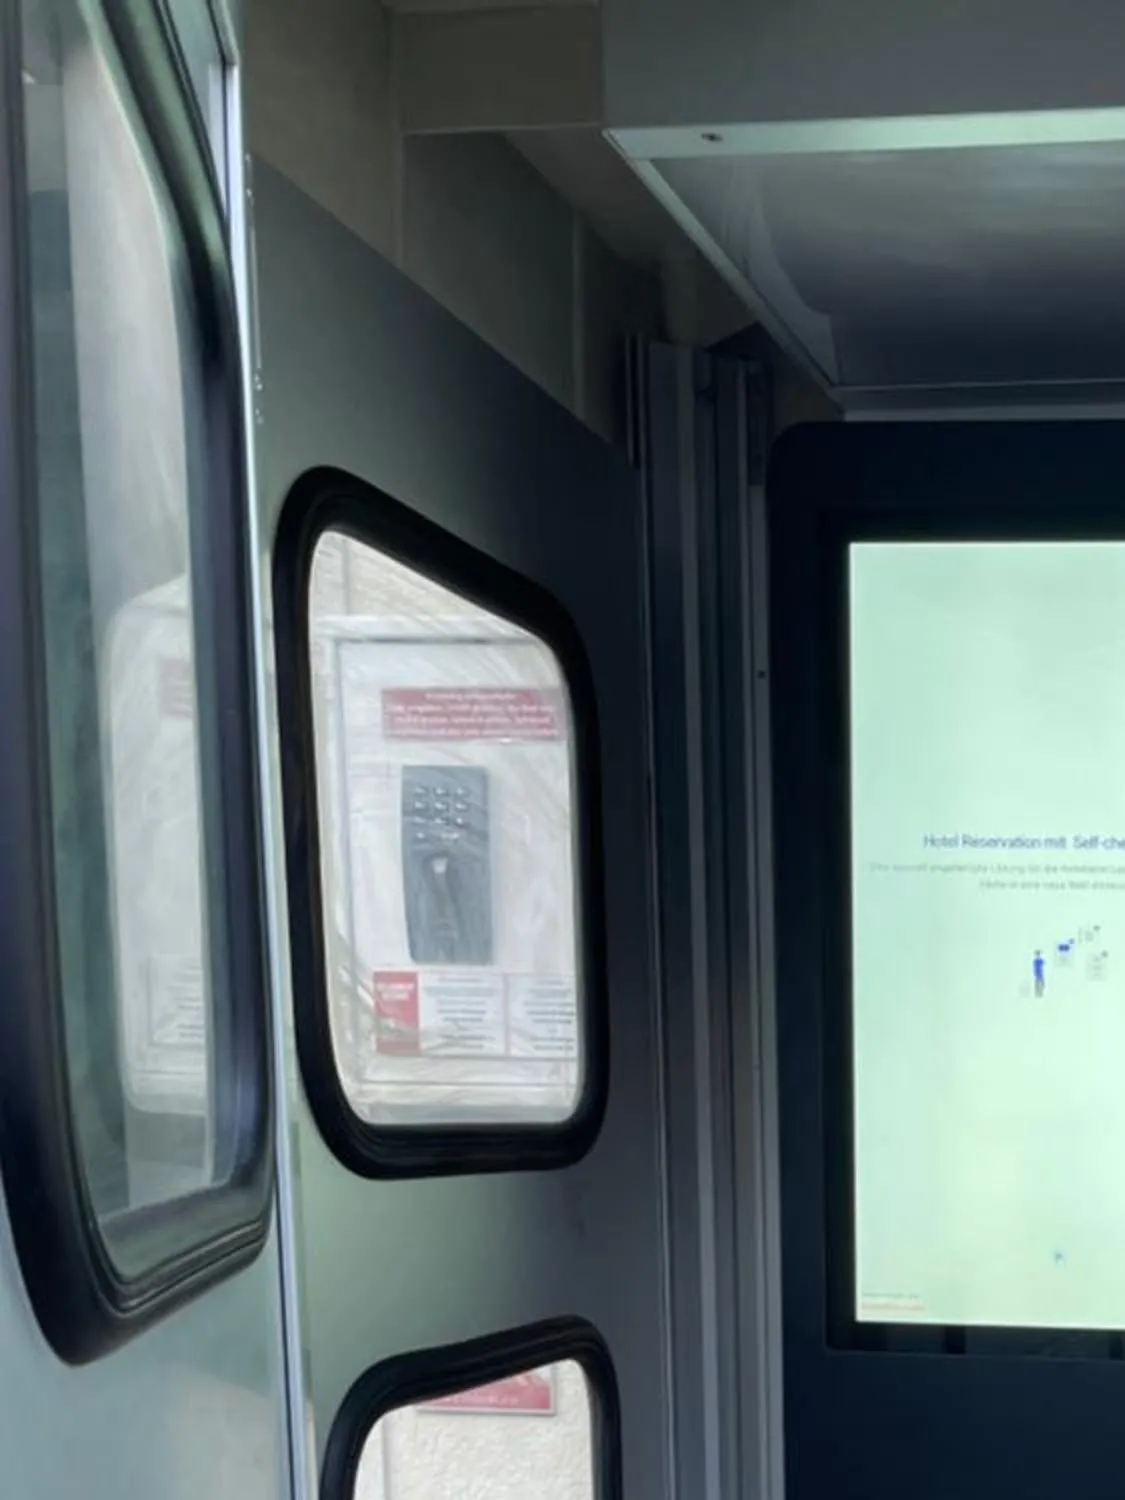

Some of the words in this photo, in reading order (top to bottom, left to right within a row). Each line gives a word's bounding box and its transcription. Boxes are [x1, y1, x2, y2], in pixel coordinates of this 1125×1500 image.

[923, 833, 959, 849] Hotel
[961, 833, 1041, 849] Reservation
[1043, 835, 1067, 849] mit
